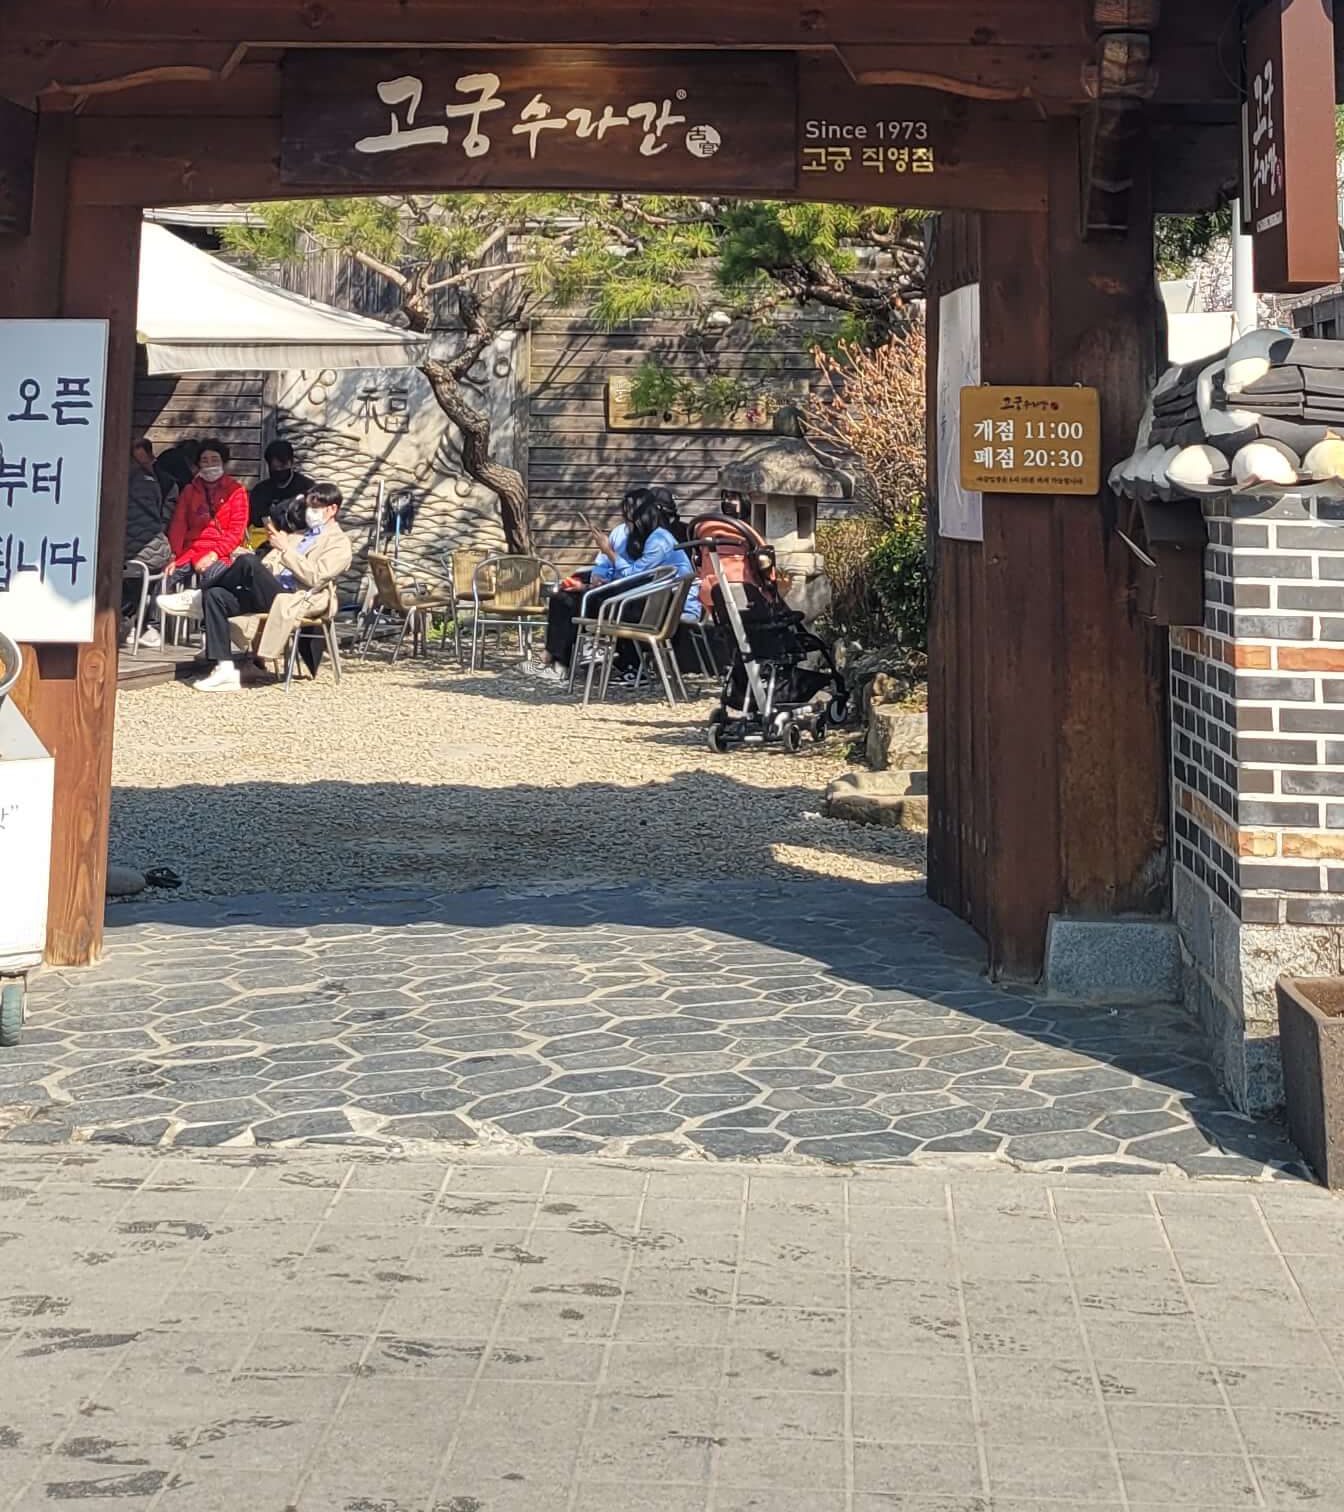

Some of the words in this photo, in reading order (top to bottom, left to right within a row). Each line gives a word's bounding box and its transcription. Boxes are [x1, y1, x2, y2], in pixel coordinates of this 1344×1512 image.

[806, 120, 868, 139] Since
[875, 121, 928, 140] 1973
[802, 147, 852, 173] 고궁
[862, 146, 934, 173] 직영점
[7, 377, 93, 426] 오픈
[973, 419, 1014, 442] 개점
[1025, 421, 1083, 440] 11:00
[1023, 449, 1083, 468] 20:30
